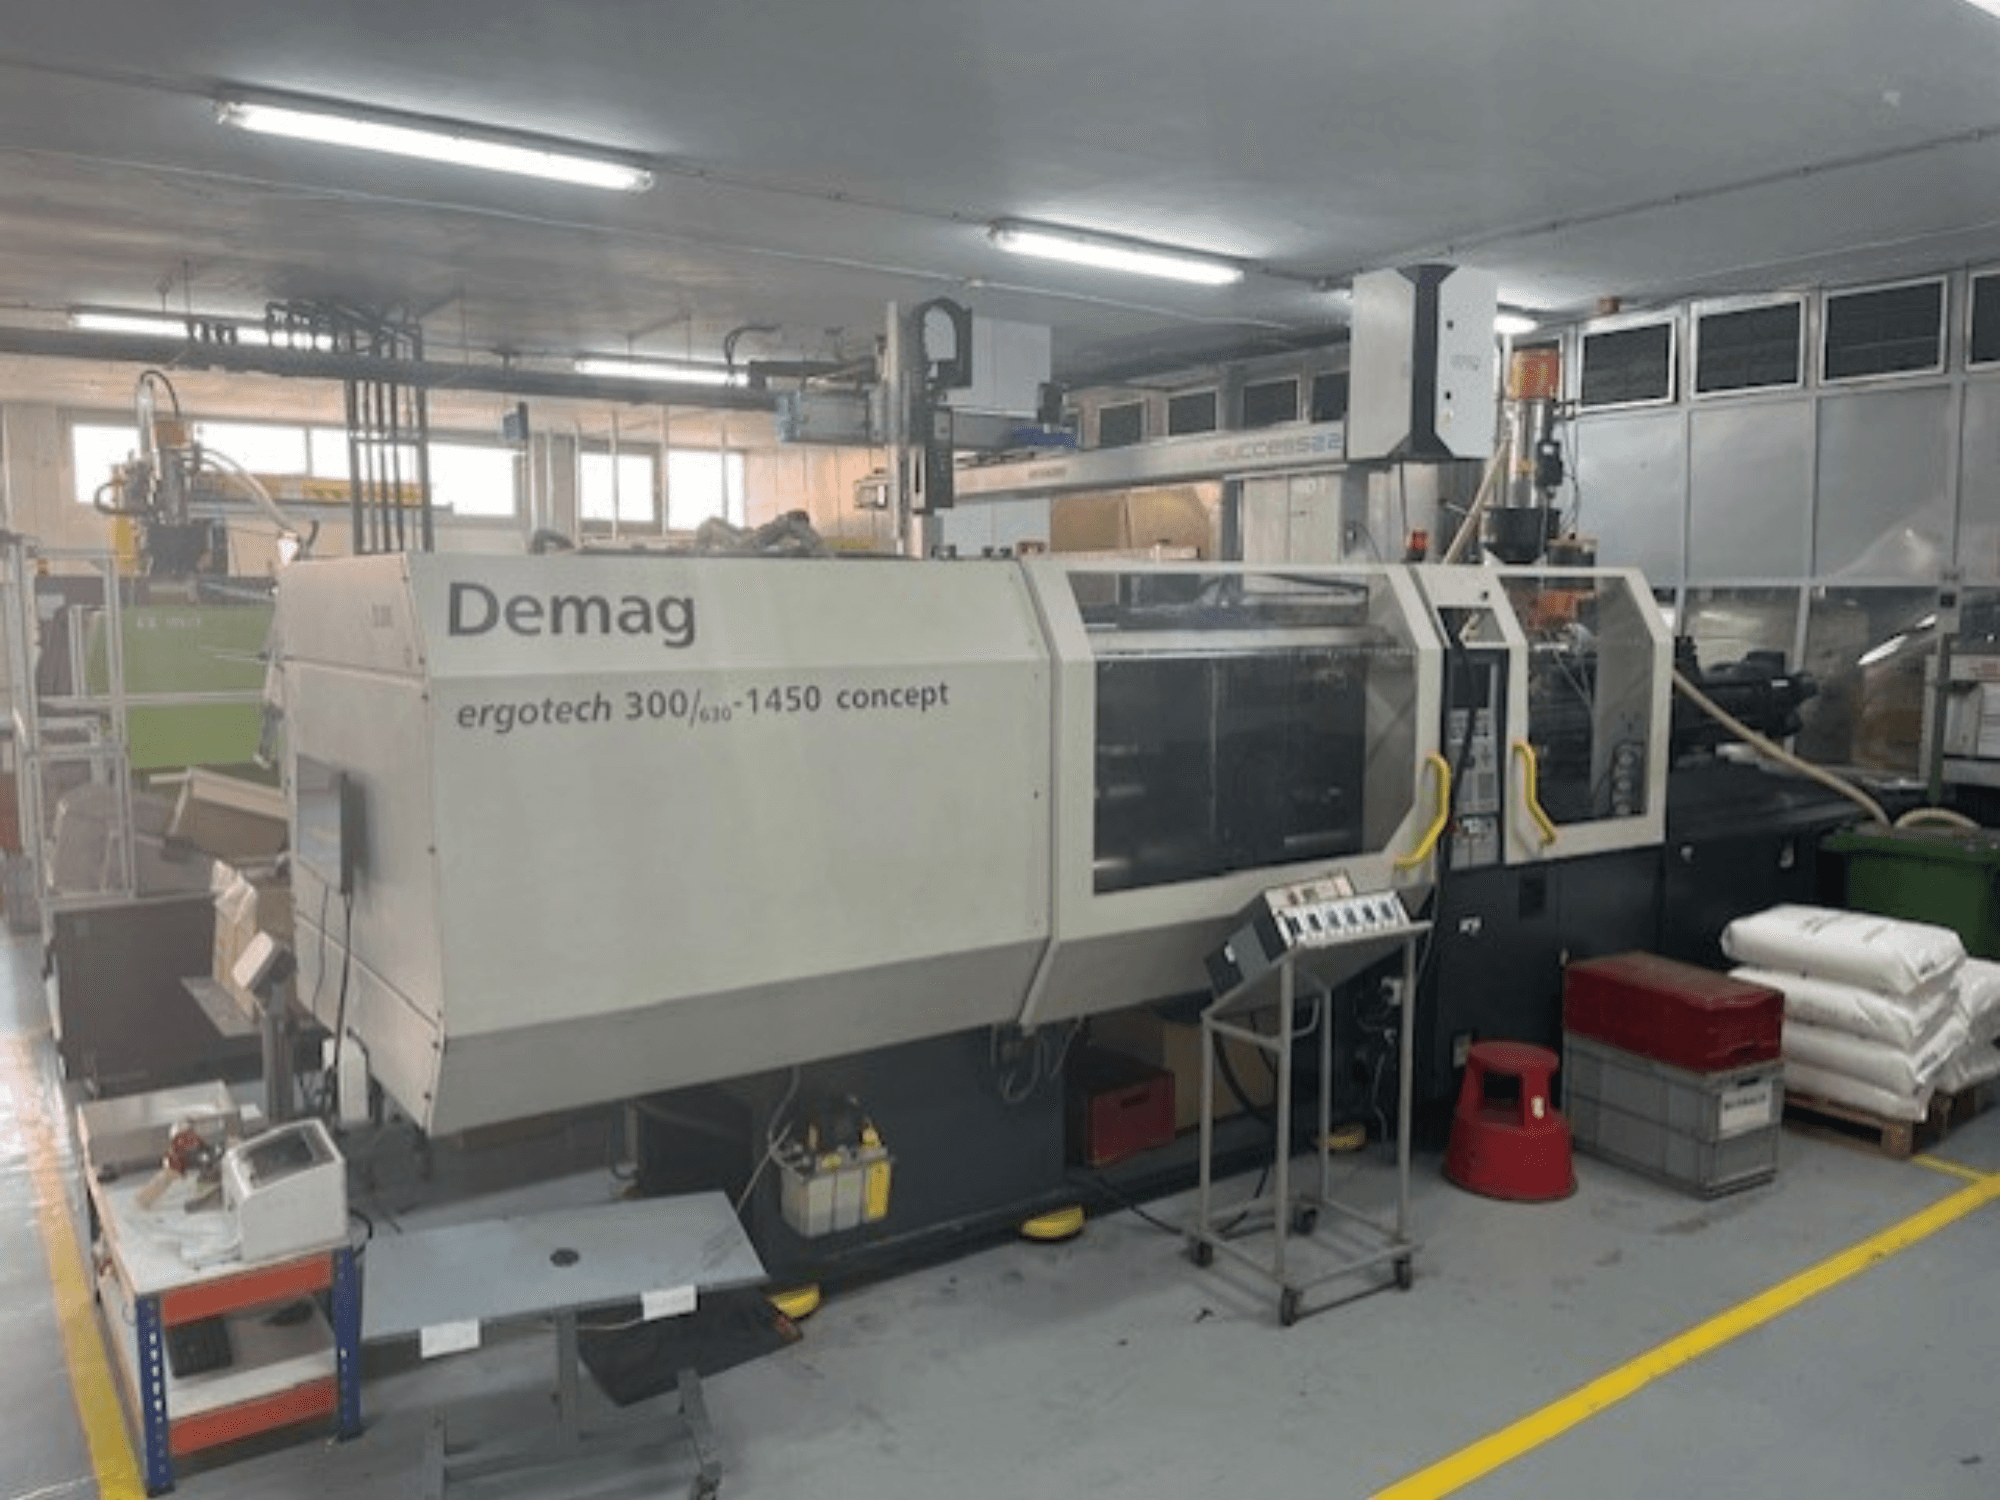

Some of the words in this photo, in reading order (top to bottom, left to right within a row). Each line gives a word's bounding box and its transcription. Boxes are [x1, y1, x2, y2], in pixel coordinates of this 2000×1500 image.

[449, 582, 696, 649] Demag
[457, 692, 611, 734] ergotech
[836, 681, 949, 712] concept
